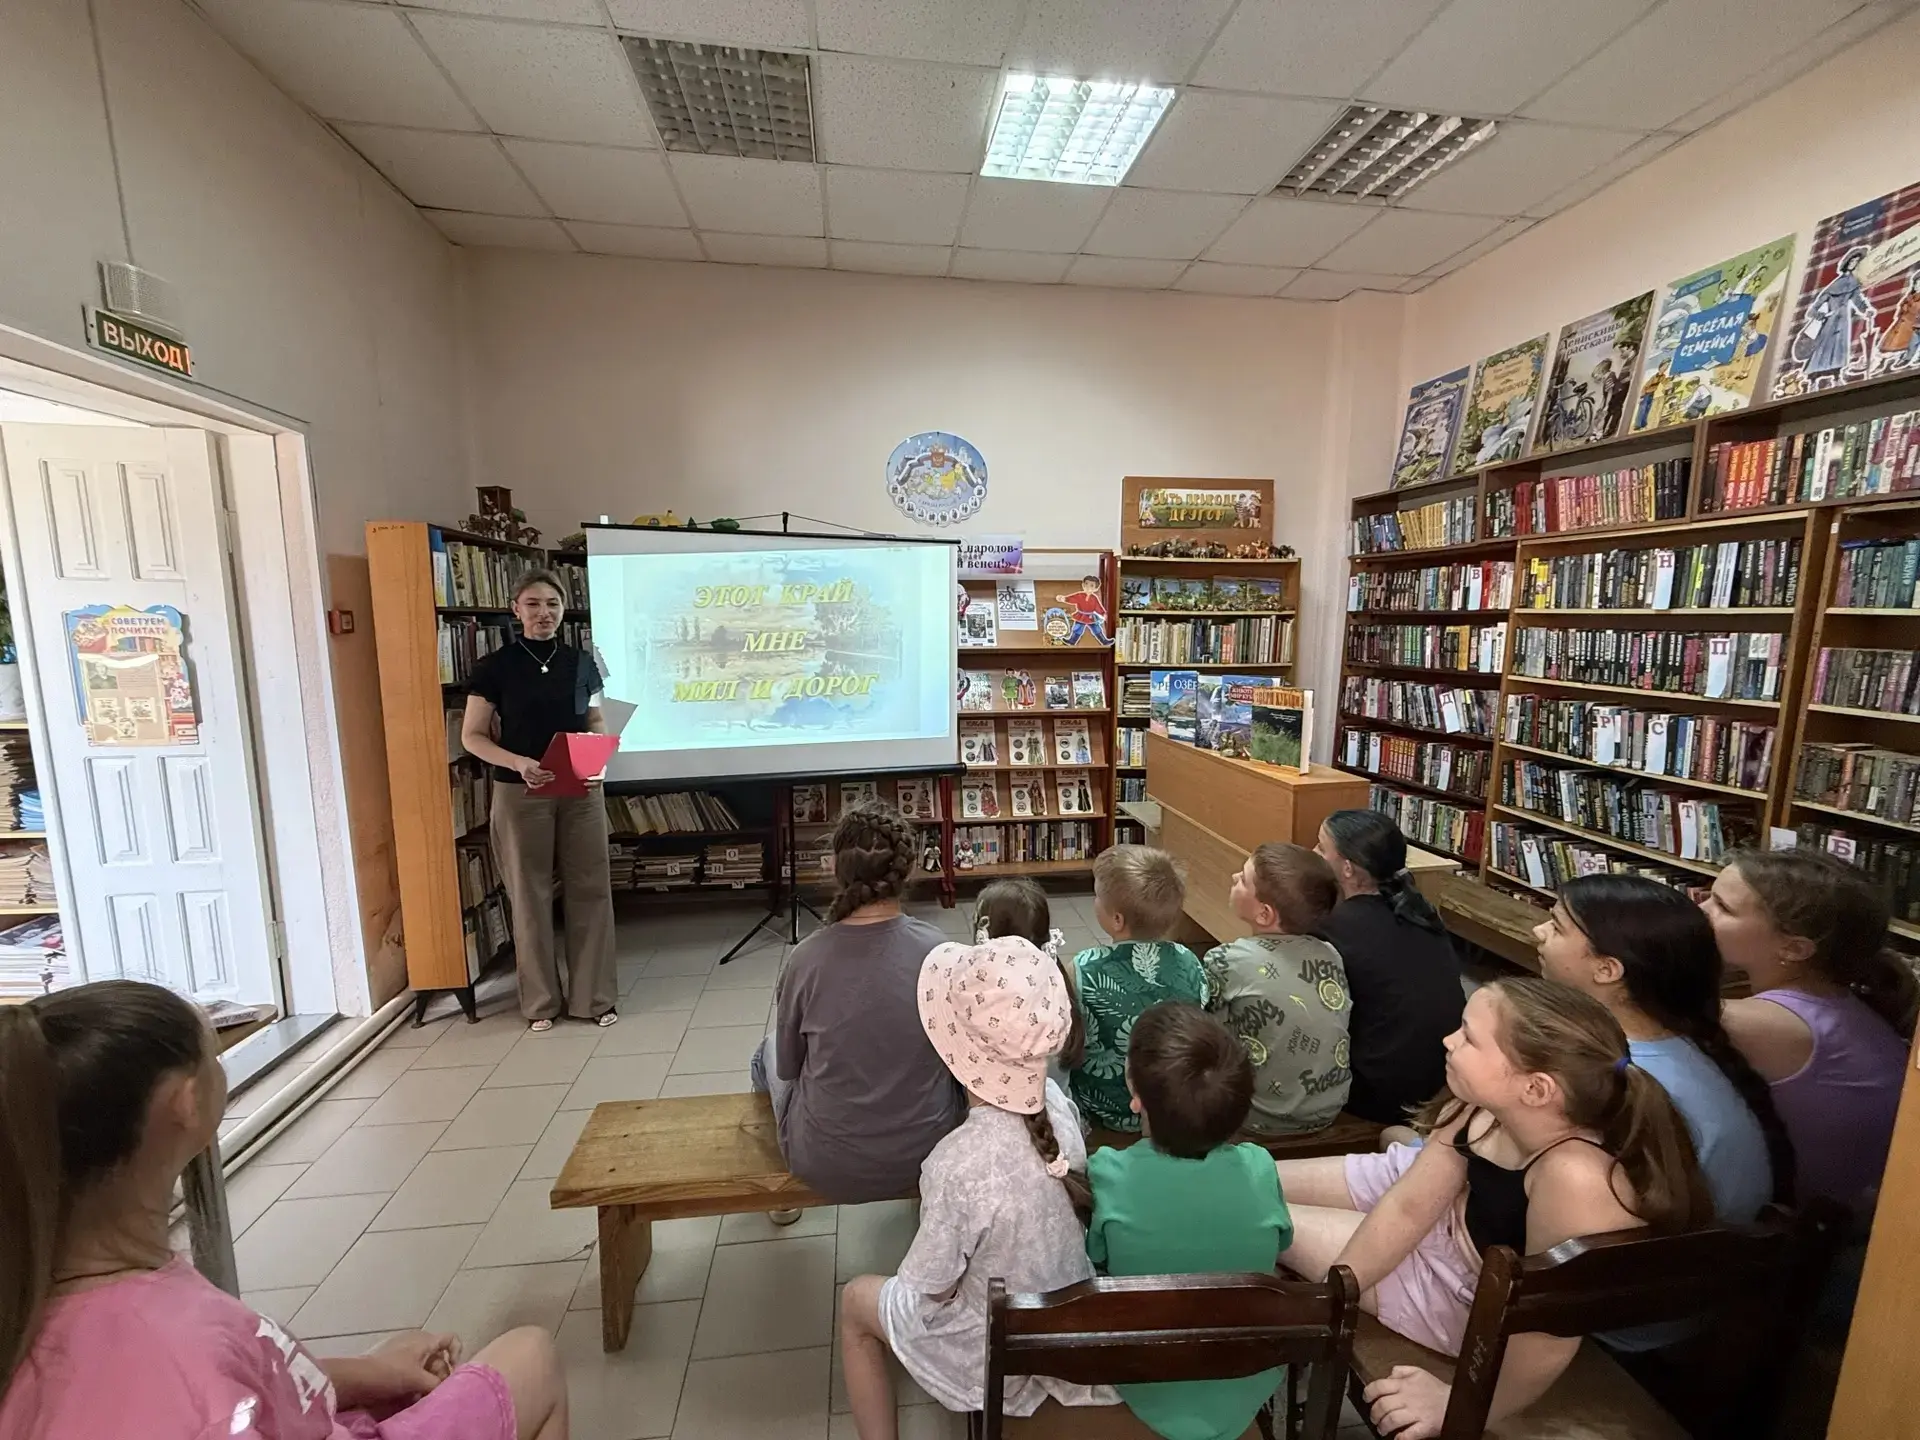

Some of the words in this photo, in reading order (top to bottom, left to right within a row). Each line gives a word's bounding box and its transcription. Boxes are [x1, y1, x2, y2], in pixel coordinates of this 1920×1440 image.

[102, 320, 184, 371] ВЫХОД
[1680, 332, 1736, 357] СЕМЕЙКА
[1657, 553, 1673, 568] Н
[1472, 569, 1481, 580] В
[693, 585, 769, 608] ЭТОТ
[779, 579, 854, 605] КРАЙ
[998, 593, 1011, 602] 20
[111, 617, 165, 626] СОВЕТУЕМ
[110, 626, 168, 635] ПОЧИТАТЬ
[1483, 630, 1491, 642] Г
[742, 630, 808, 653] МНЕ
[1711, 640, 1728, 655] П
[672, 679, 738, 703] МИЛ
[750, 678, 774, 701] И
[783, 672, 880, 700] ДОРОГ
[1442, 692, 1453, 705] Д
[1600, 716, 1611, 728] Р
[1652, 722, 1664, 735] С
[1349, 732, 1356, 741] Е
[1371, 738, 1378, 747] З
[1682, 804, 1693, 818] Т
[1523, 842, 1534, 854] У
[1831, 838, 1851, 856] Б
[669, 864, 677, 873] К
[714, 865, 722, 874] Н
